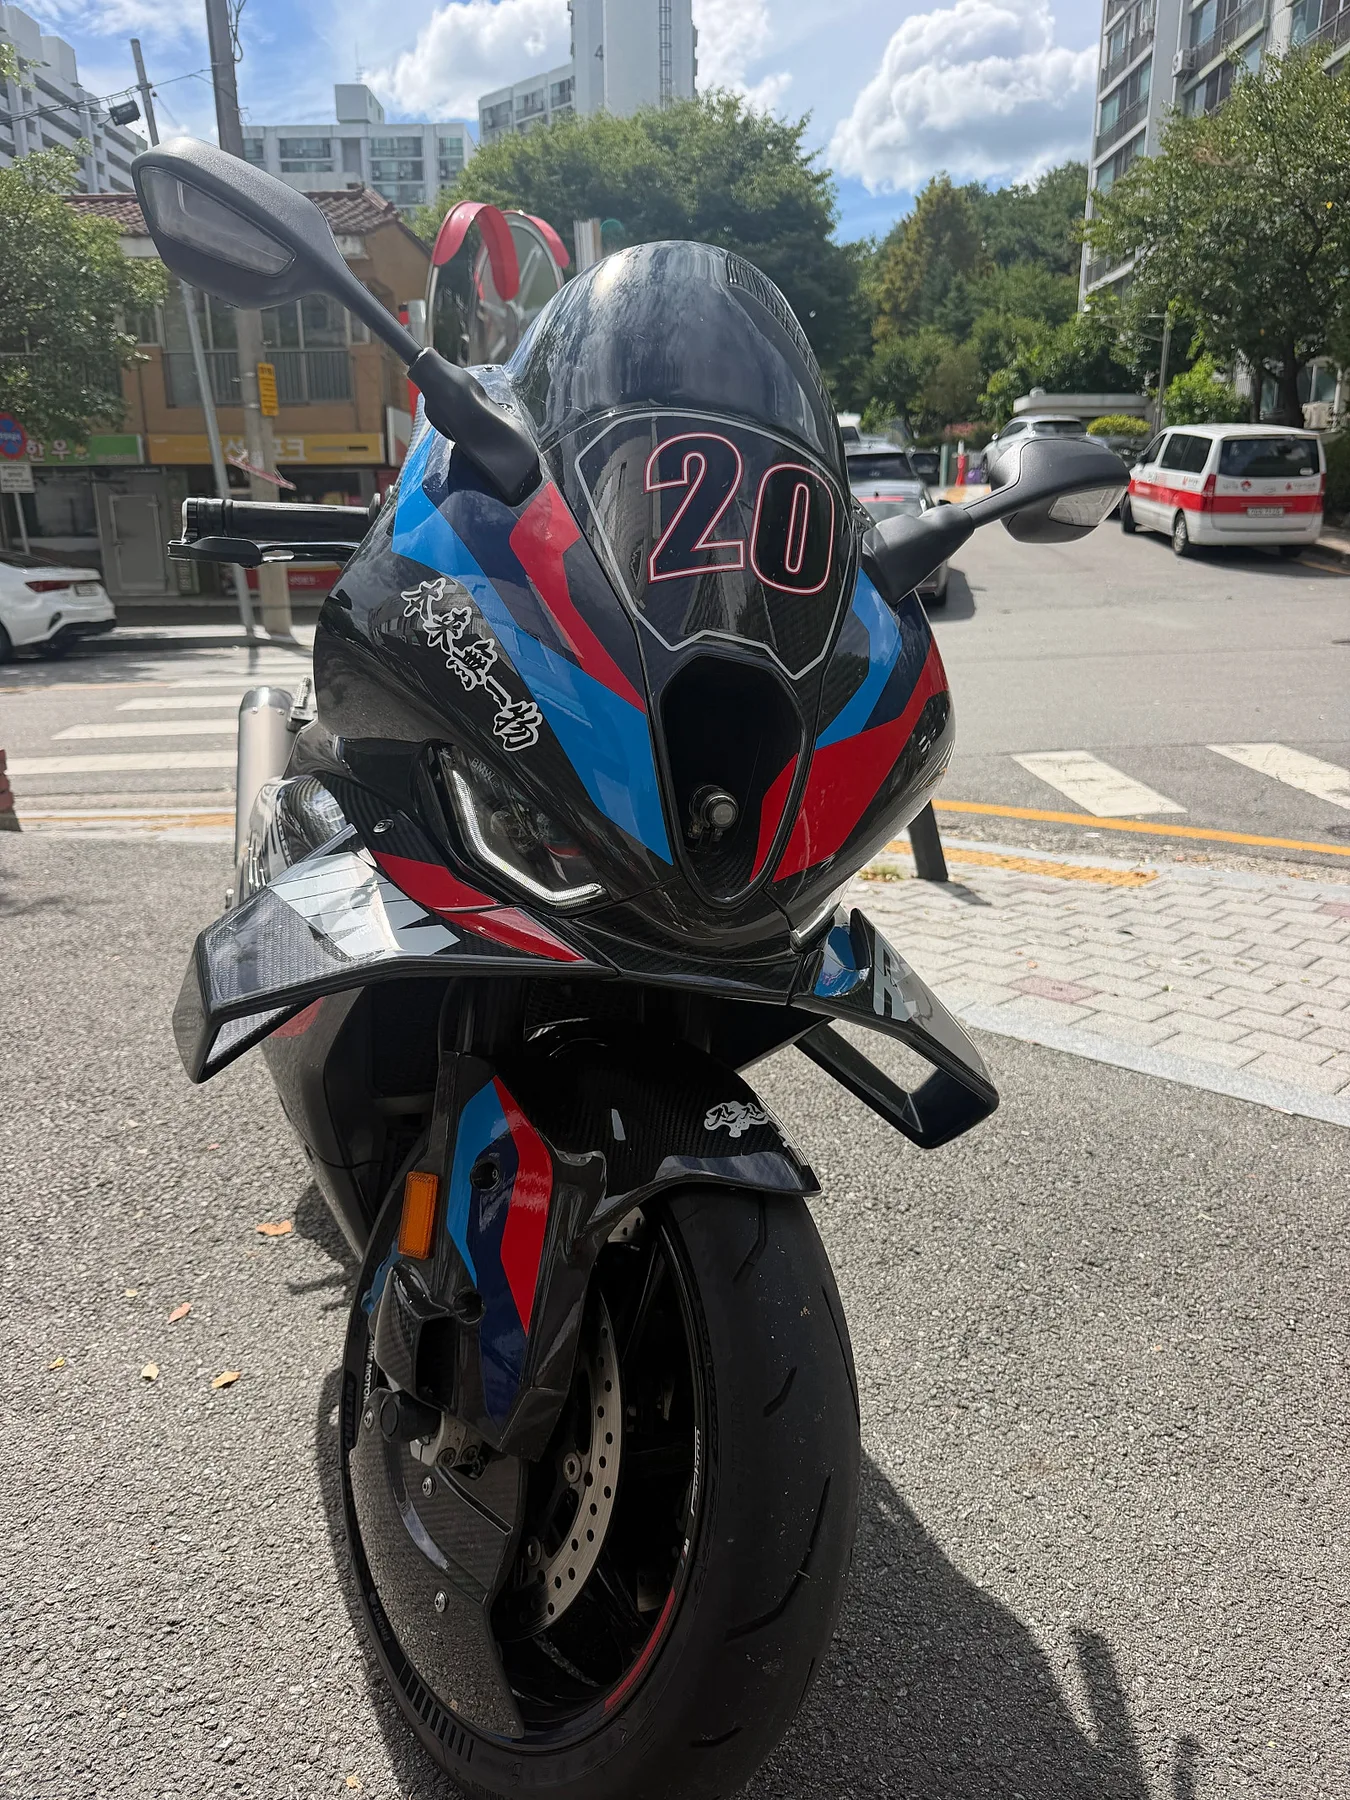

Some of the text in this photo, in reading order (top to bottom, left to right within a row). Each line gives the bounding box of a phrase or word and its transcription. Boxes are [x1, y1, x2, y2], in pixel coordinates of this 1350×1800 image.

[26, 439, 72, 462] 한우
[643, 431, 835, 596] 20
[470, 757, 496, 781] BMW
[366, 1335, 376, 1363] MW
[373, 1606, 392, 1642] FRONT
